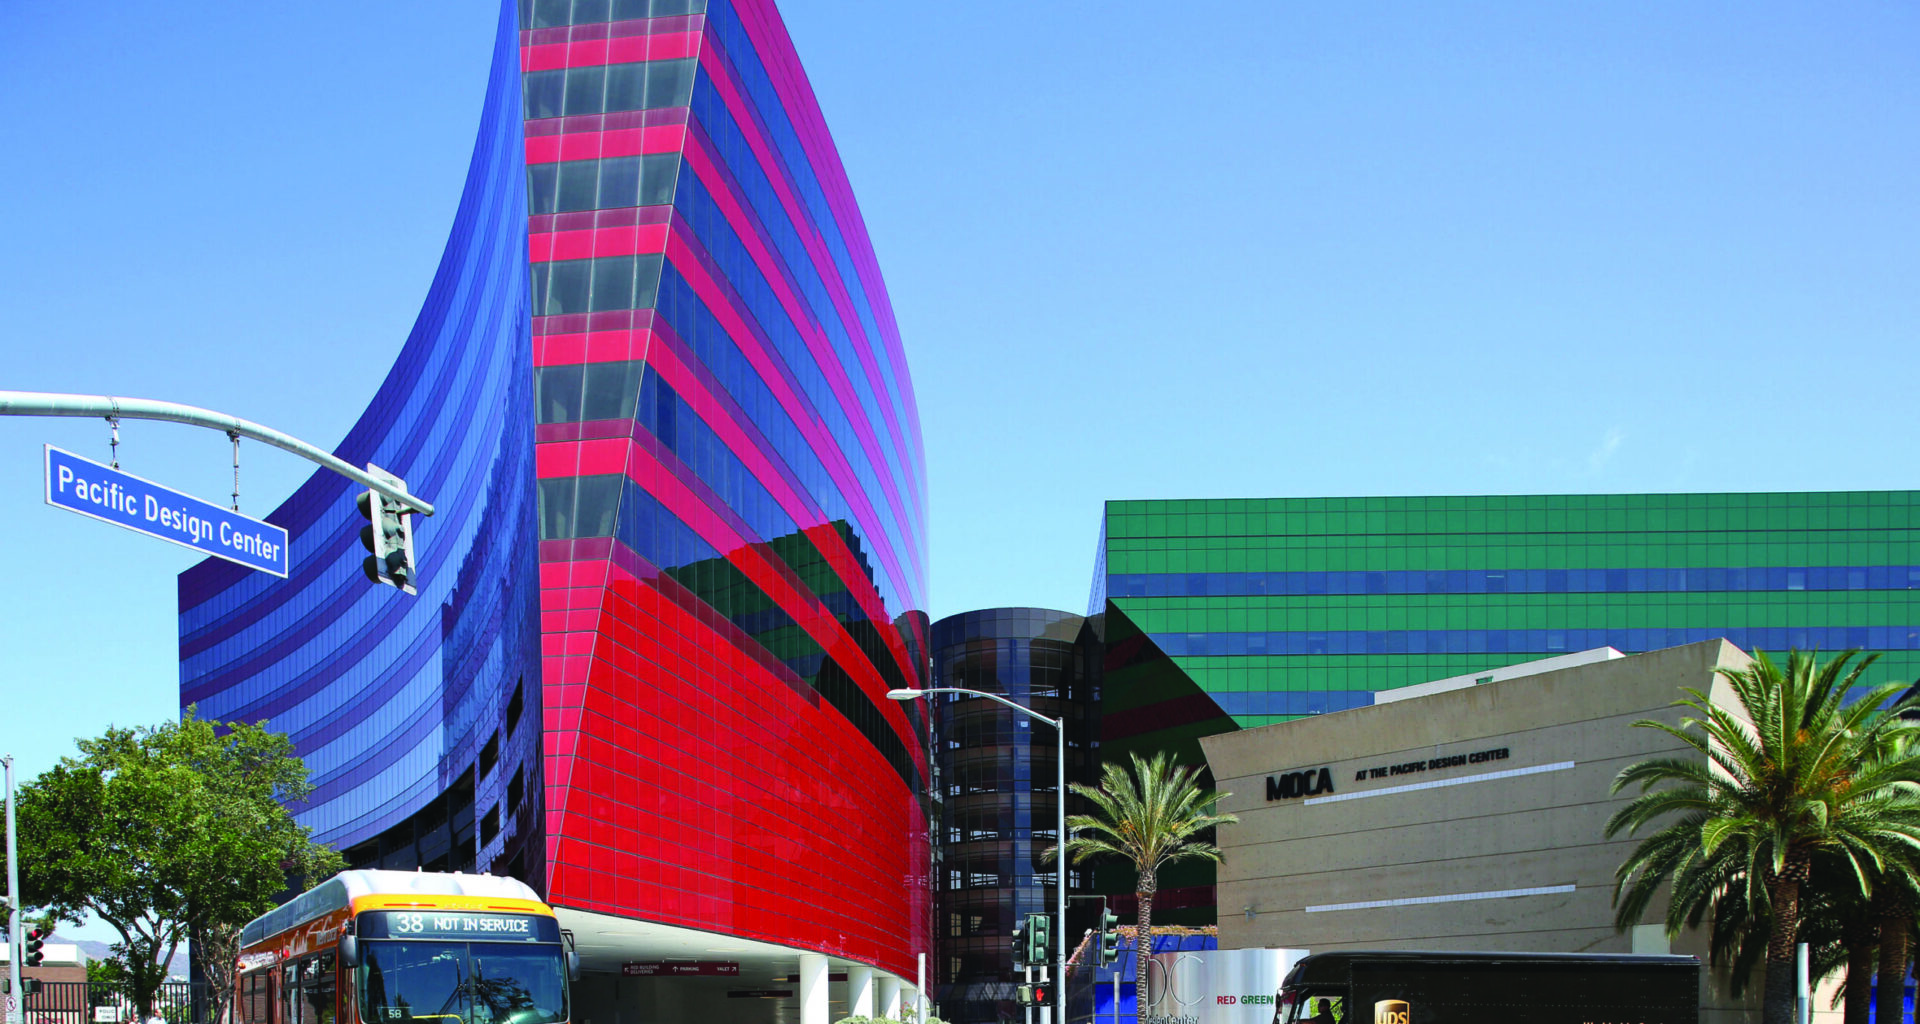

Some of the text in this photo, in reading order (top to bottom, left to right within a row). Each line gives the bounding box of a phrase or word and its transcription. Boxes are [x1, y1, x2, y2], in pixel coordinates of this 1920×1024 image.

[58, 464, 280, 562] Pacific Design Center
[1266, 748, 1510, 802] MOCA AT THE PACIFIC DESIGN CENTER
[397, 913, 529, 933] 38 NOT IN SERVICE
[1217, 995, 1274, 1005] RED GREEN
